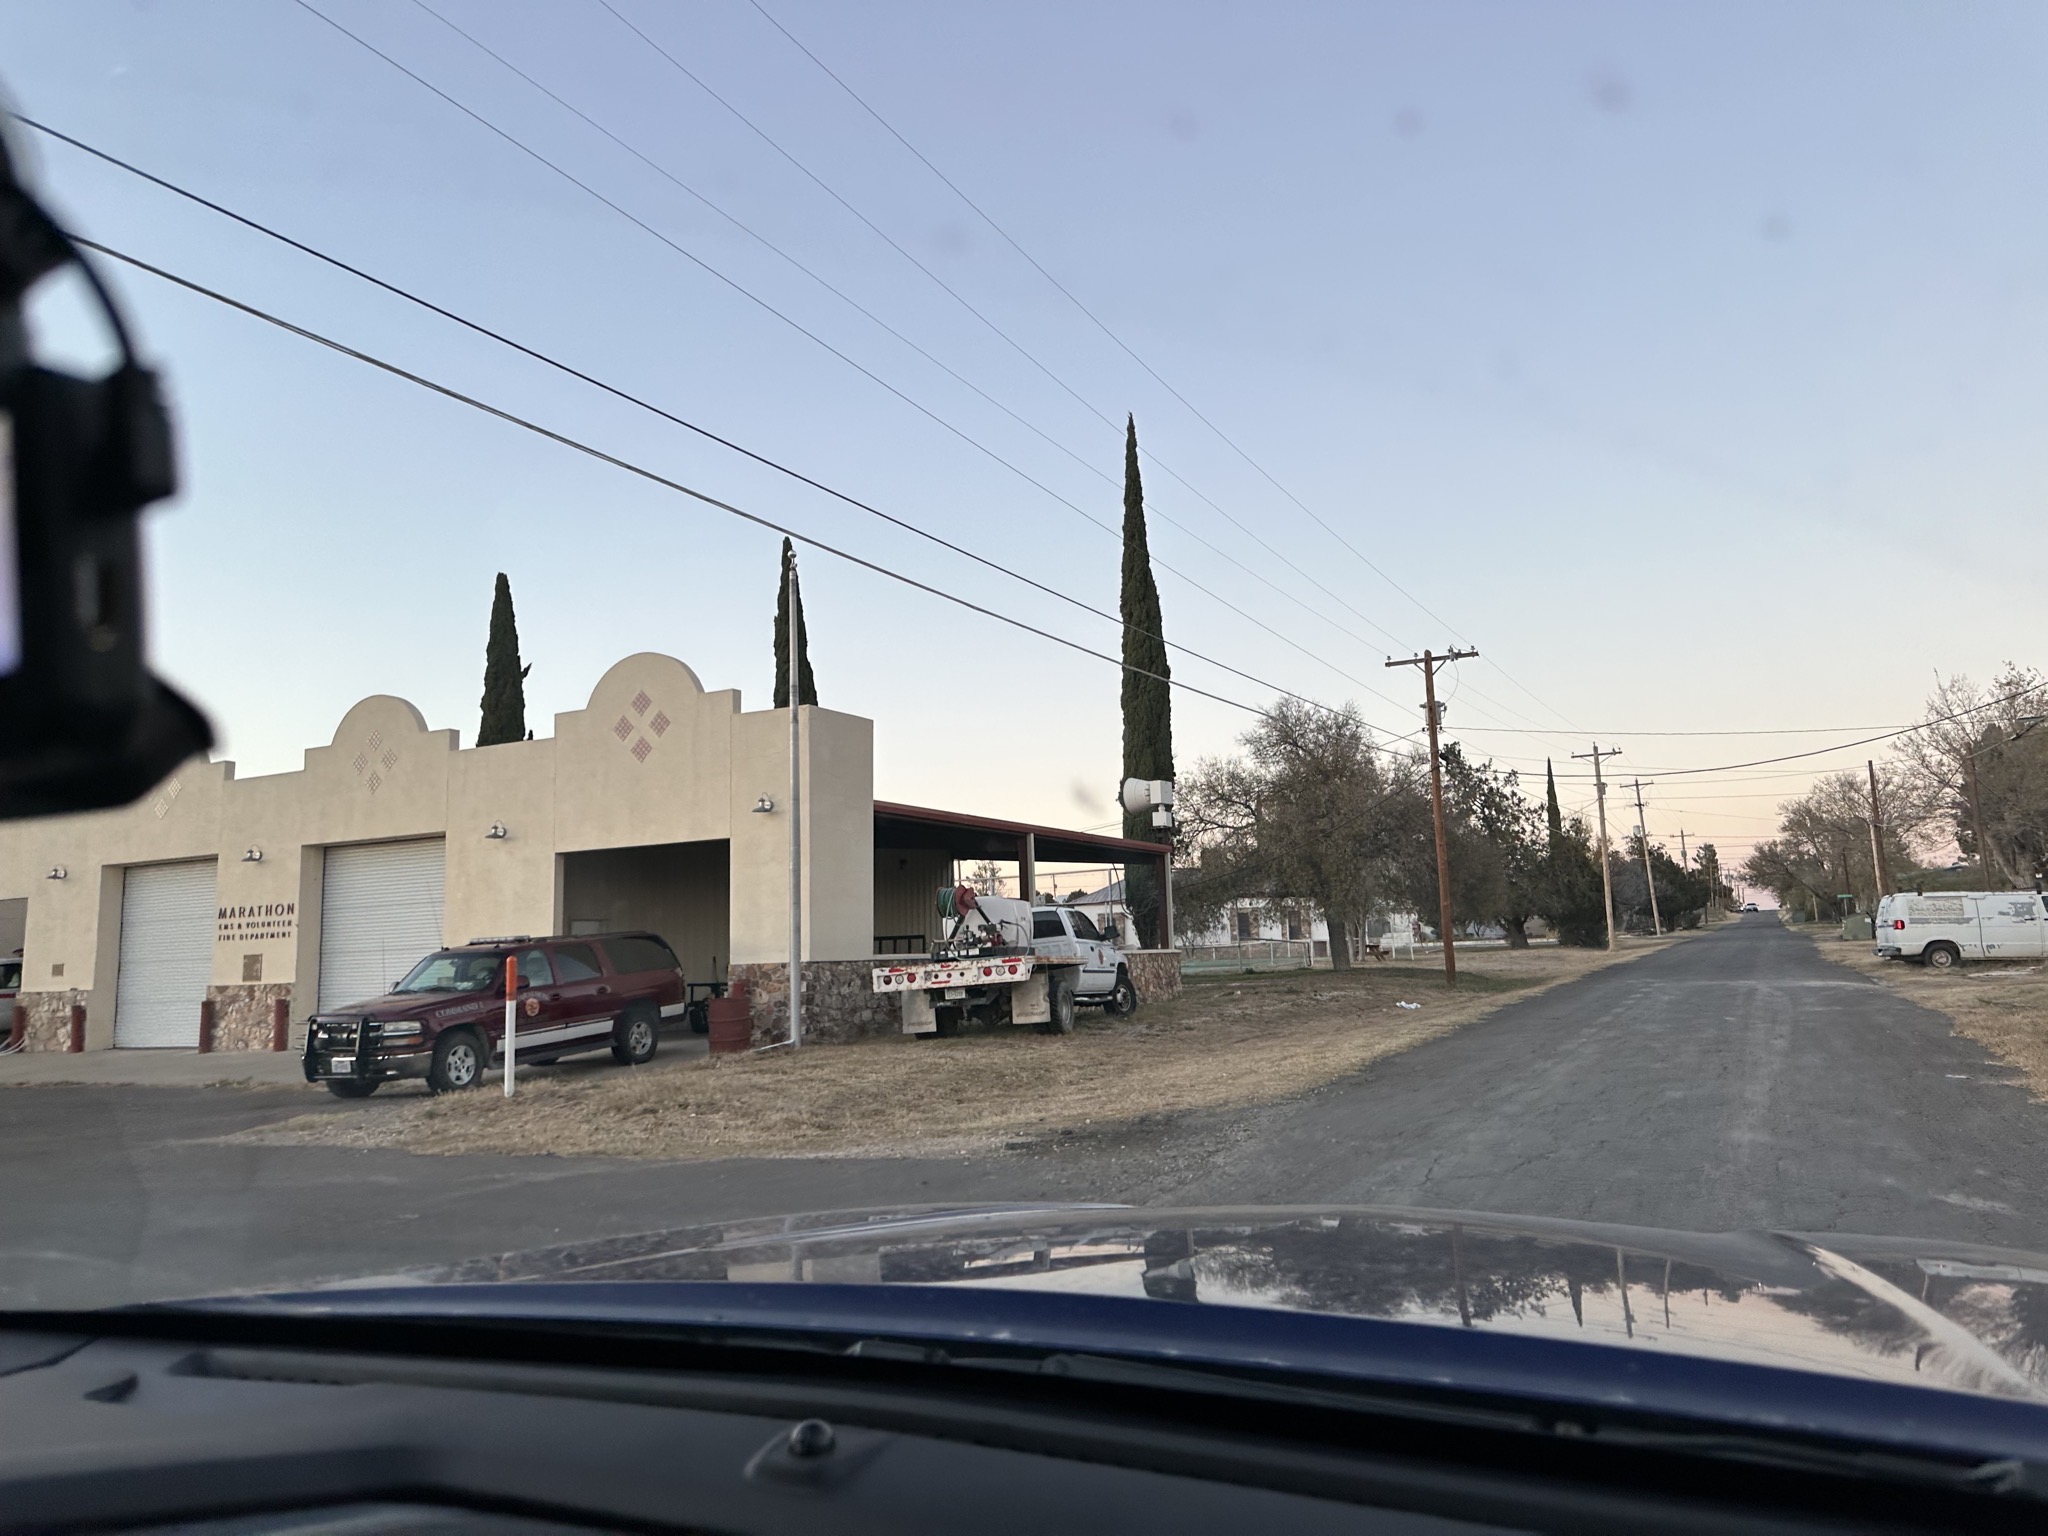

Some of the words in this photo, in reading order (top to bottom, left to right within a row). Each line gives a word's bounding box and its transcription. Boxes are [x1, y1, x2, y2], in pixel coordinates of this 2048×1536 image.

[218, 903, 295, 919] MARATHON
[218, 922, 234, 931] EMS
[246, 920, 292, 929] VOLUNTEER
[218, 933, 236, 941] FIRE
[239, 931, 292, 940] DEPARTMENT
